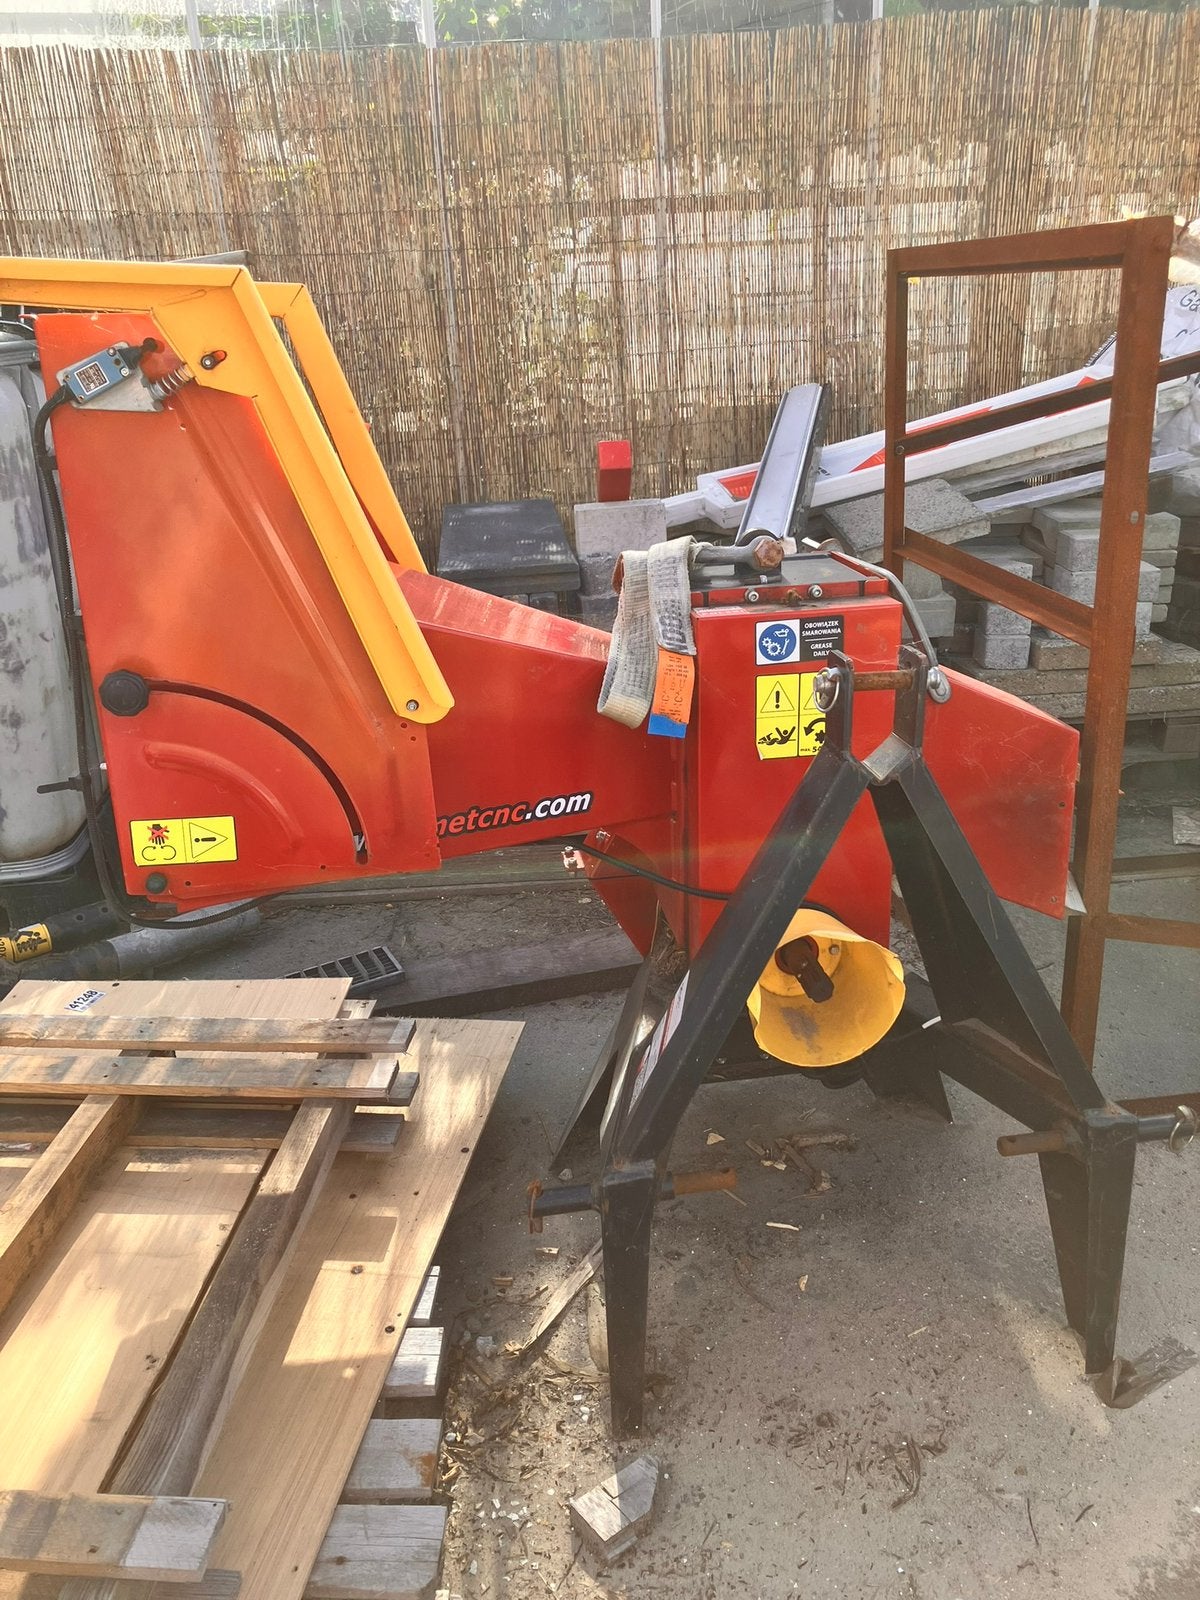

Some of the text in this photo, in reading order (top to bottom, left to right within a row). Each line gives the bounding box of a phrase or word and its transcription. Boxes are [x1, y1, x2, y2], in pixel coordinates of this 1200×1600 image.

[804, 620, 839, 629] OBOWIĄZEK
[802, 628, 841, 637] SMAROWANIA
[810, 642, 833, 650] GREASE
[69, 989, 98, 1009] 41248
